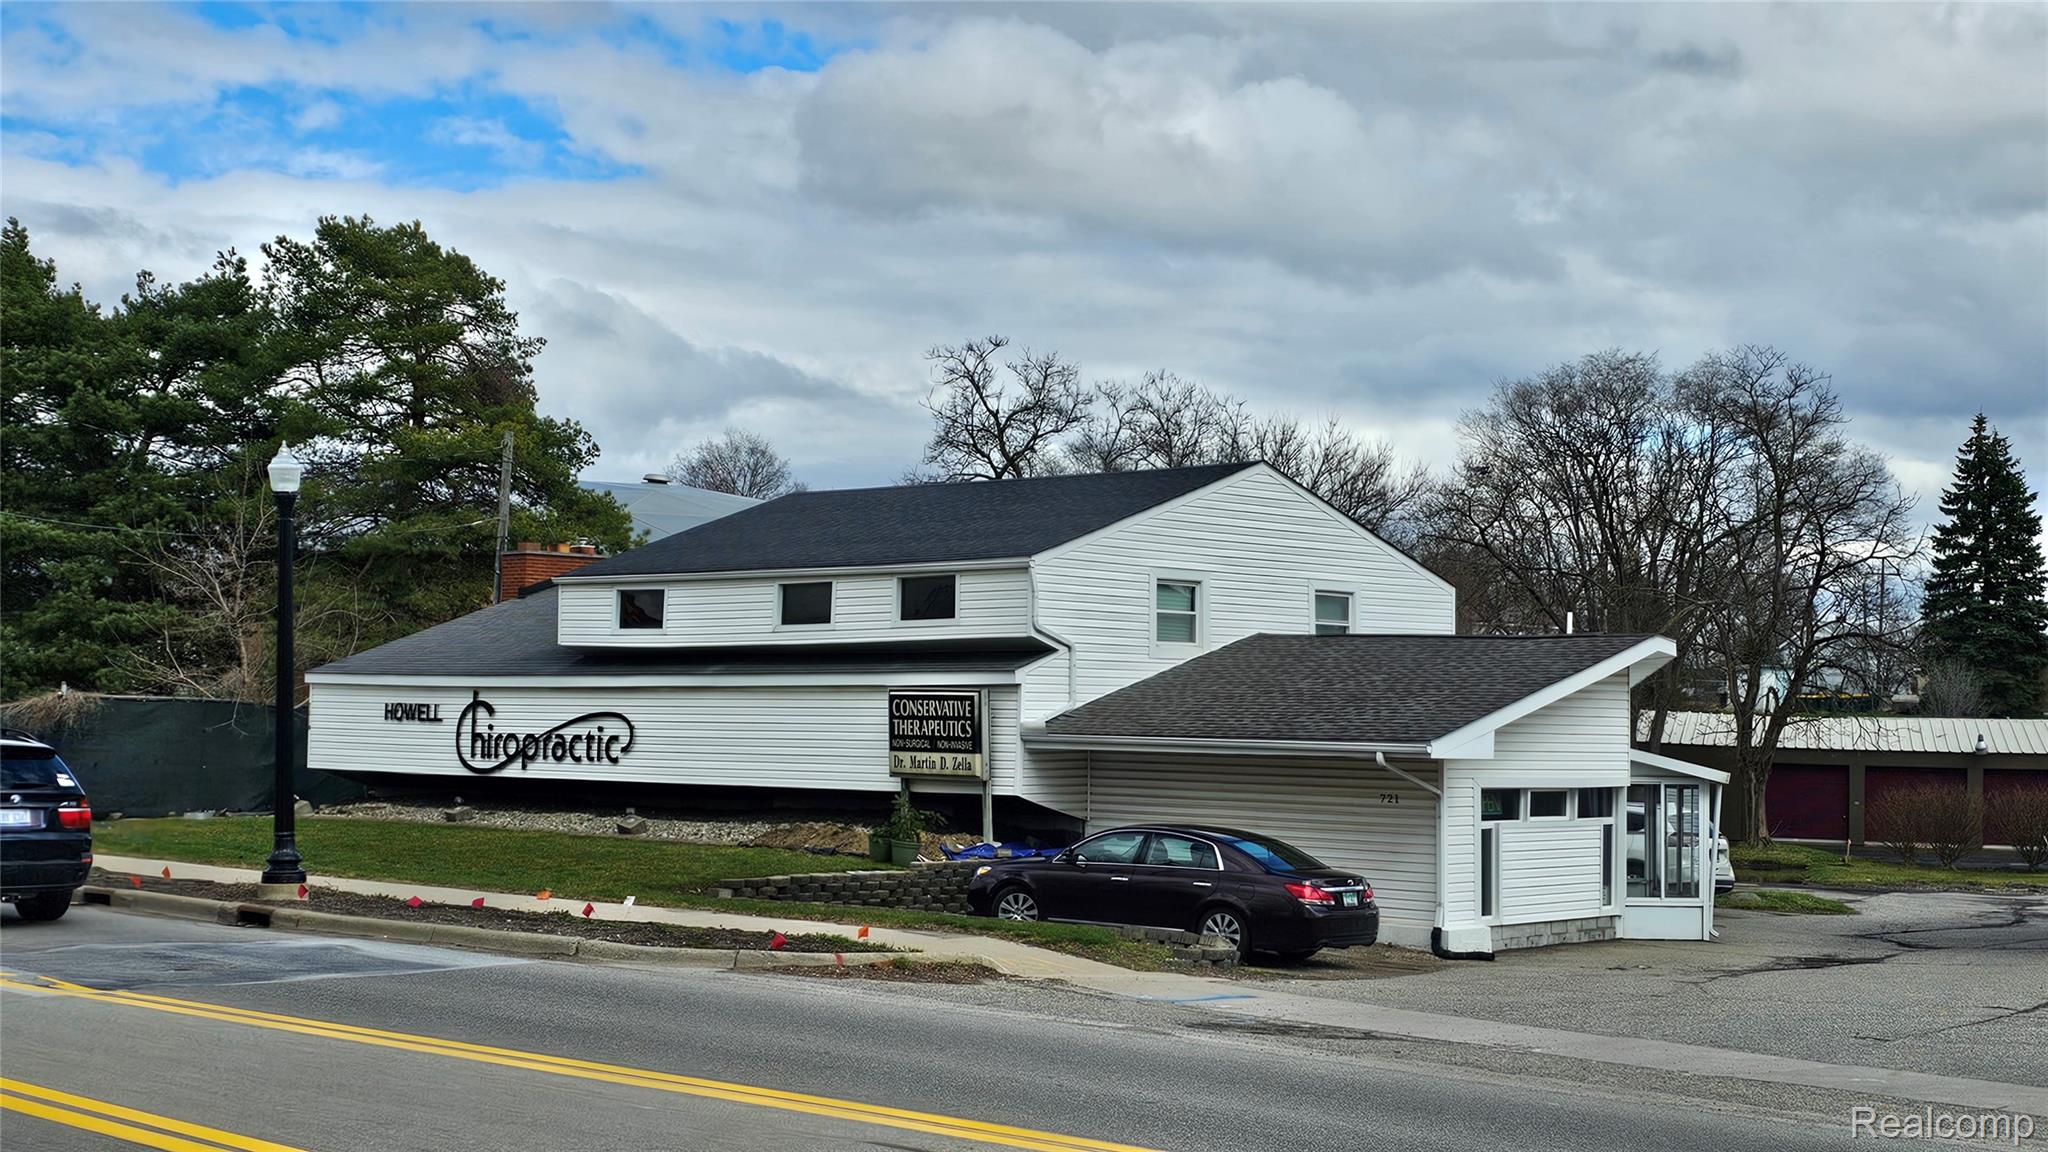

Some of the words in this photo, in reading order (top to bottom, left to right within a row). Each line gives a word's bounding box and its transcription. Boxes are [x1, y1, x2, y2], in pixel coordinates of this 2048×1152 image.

[892, 699, 972, 717] CONSERVATIVE
[384, 702, 443, 722] HOWELL
[456, 689, 635, 775] Chiropractic
[892, 719, 972, 737] THERAPEUTICS
[892, 738, 931, 749] NON-SURGICAL
[936, 740, 973, 750] NON-INVASIVE
[893, 754, 906, 769] Dr.
[909, 755, 936, 770] Martin
[940, 756, 949, 770] D.
[952, 757, 972, 771] Zella
[1380, 793, 1399, 804] 721
